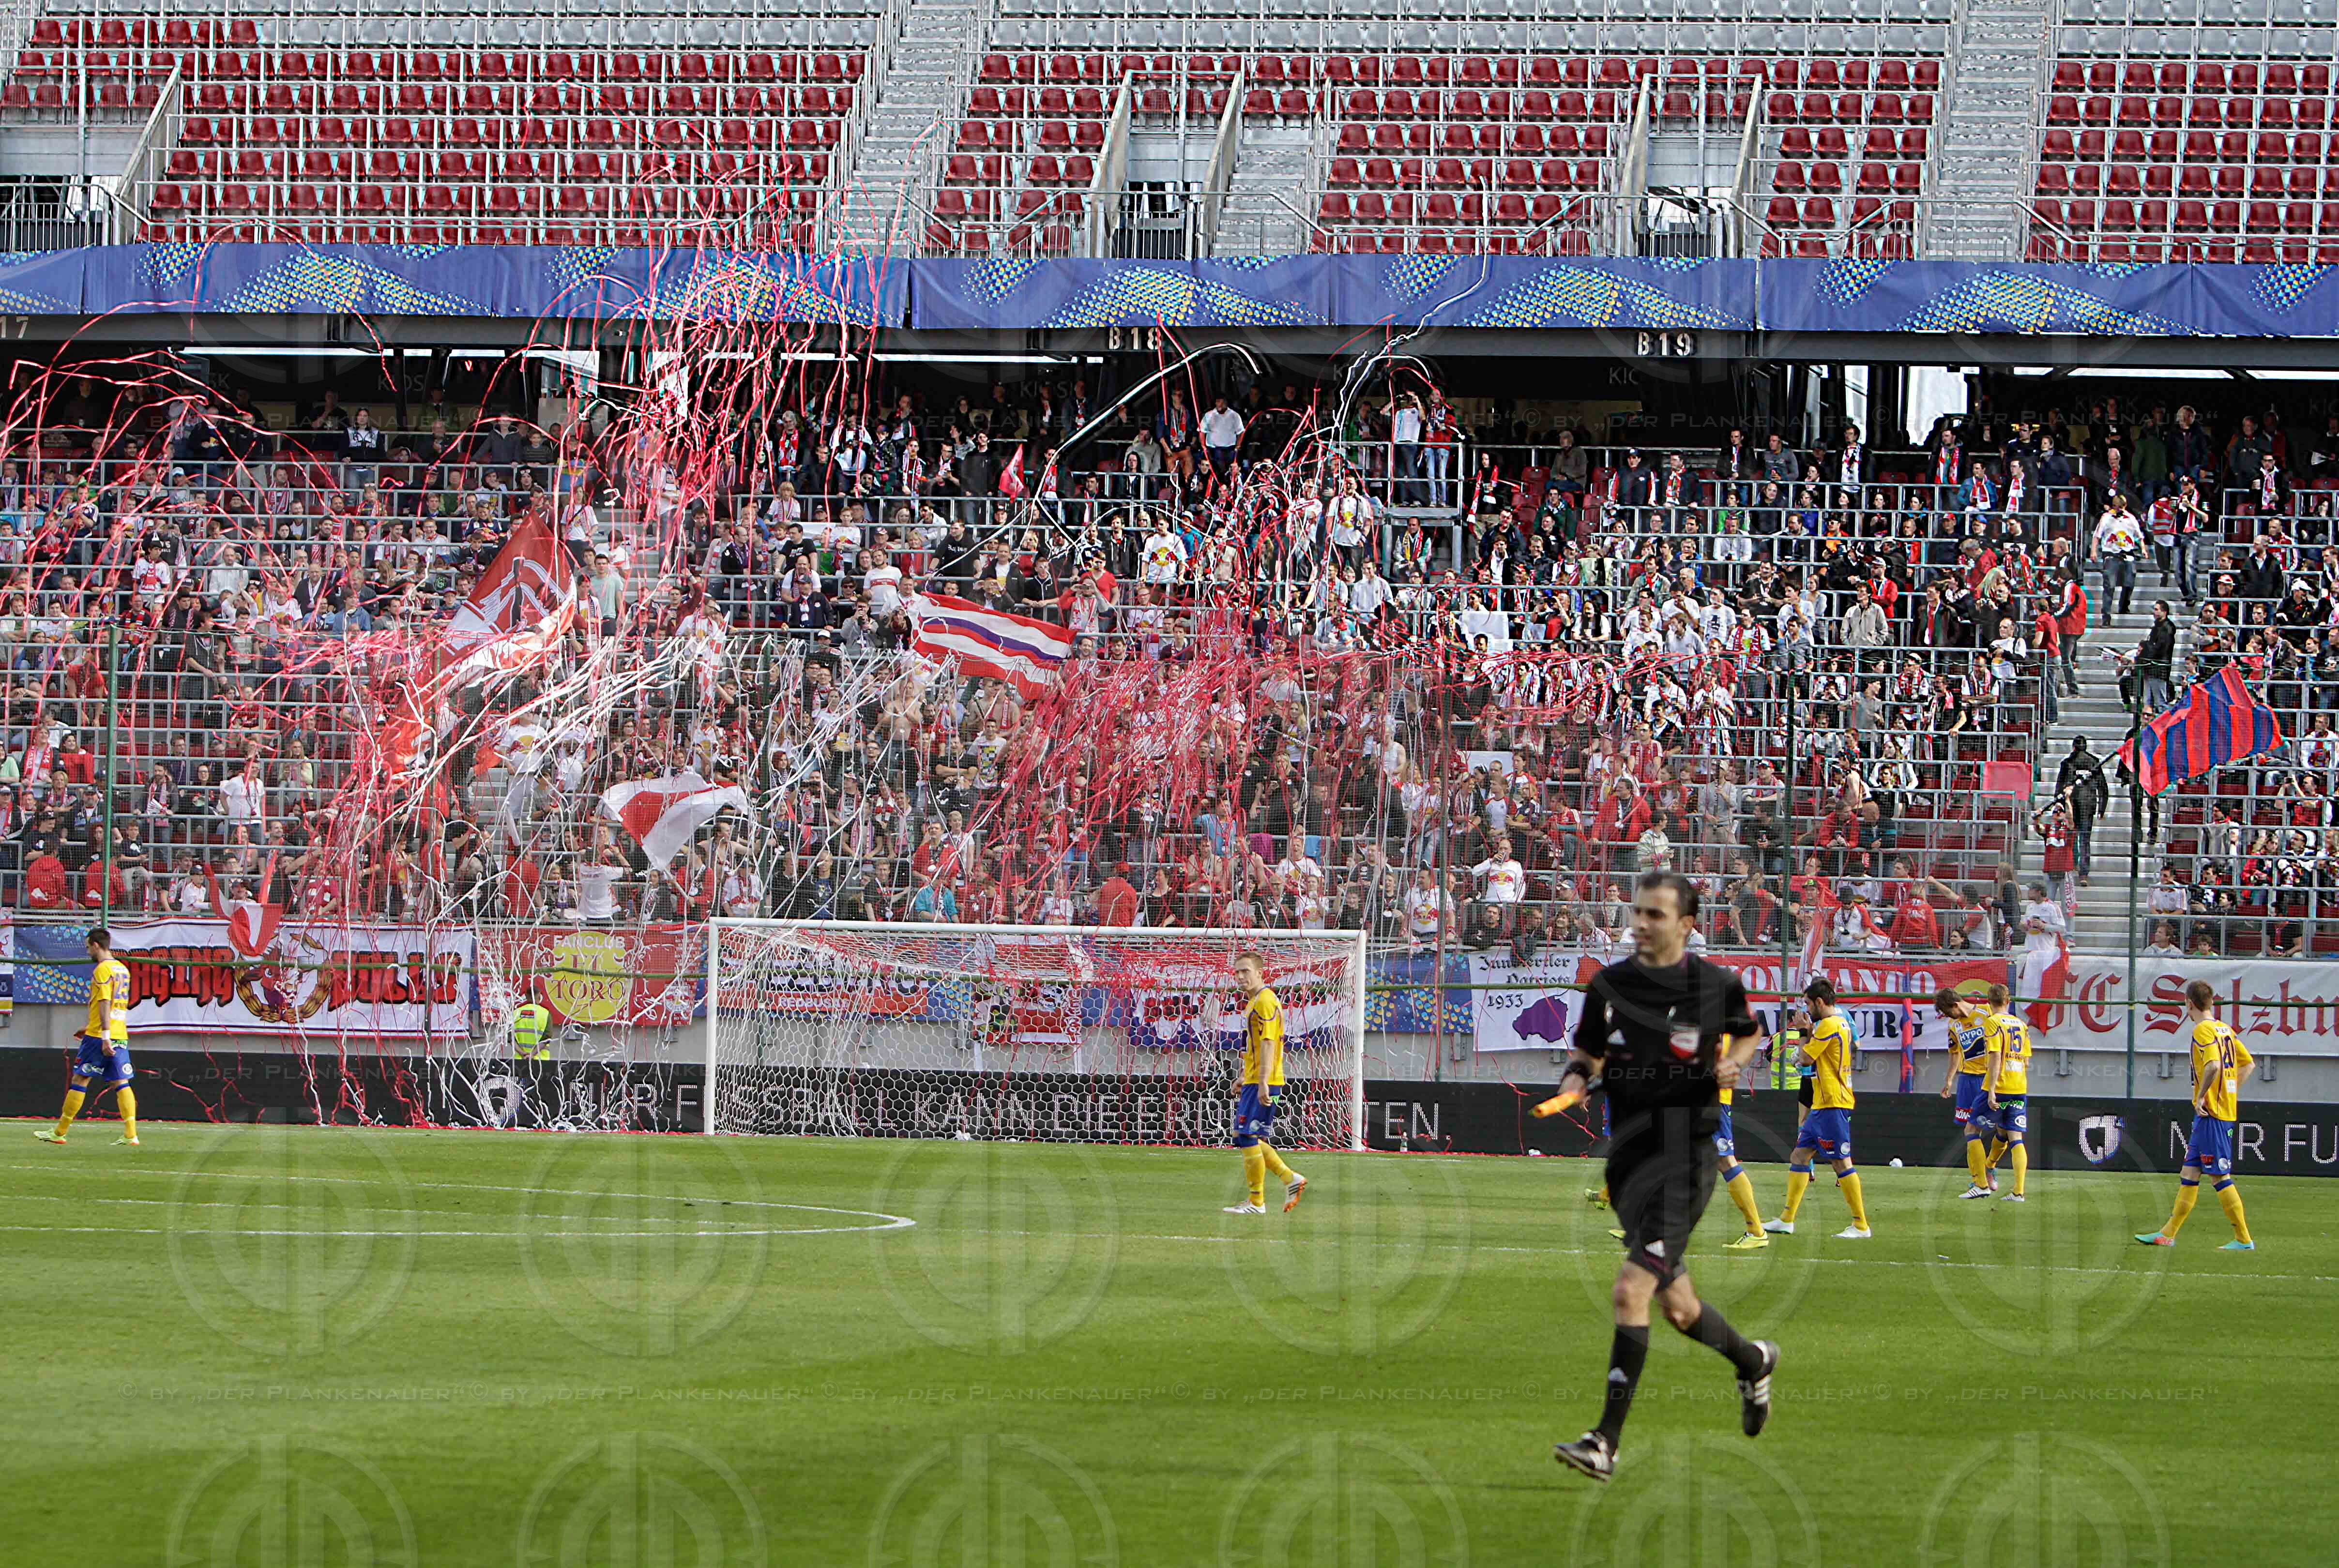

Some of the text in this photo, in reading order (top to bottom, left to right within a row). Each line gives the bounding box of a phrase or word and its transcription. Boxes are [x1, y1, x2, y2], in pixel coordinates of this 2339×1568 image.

[553, 935, 626, 949] FANCLUB
[551, 979, 626, 1000] TORO
[1488, 993, 1524, 1009] 1933
[1959, 1027, 1983, 1042] HYPO
[2007, 1026, 2022, 1053] 15
[2170, 1121, 2265, 1161] NR
